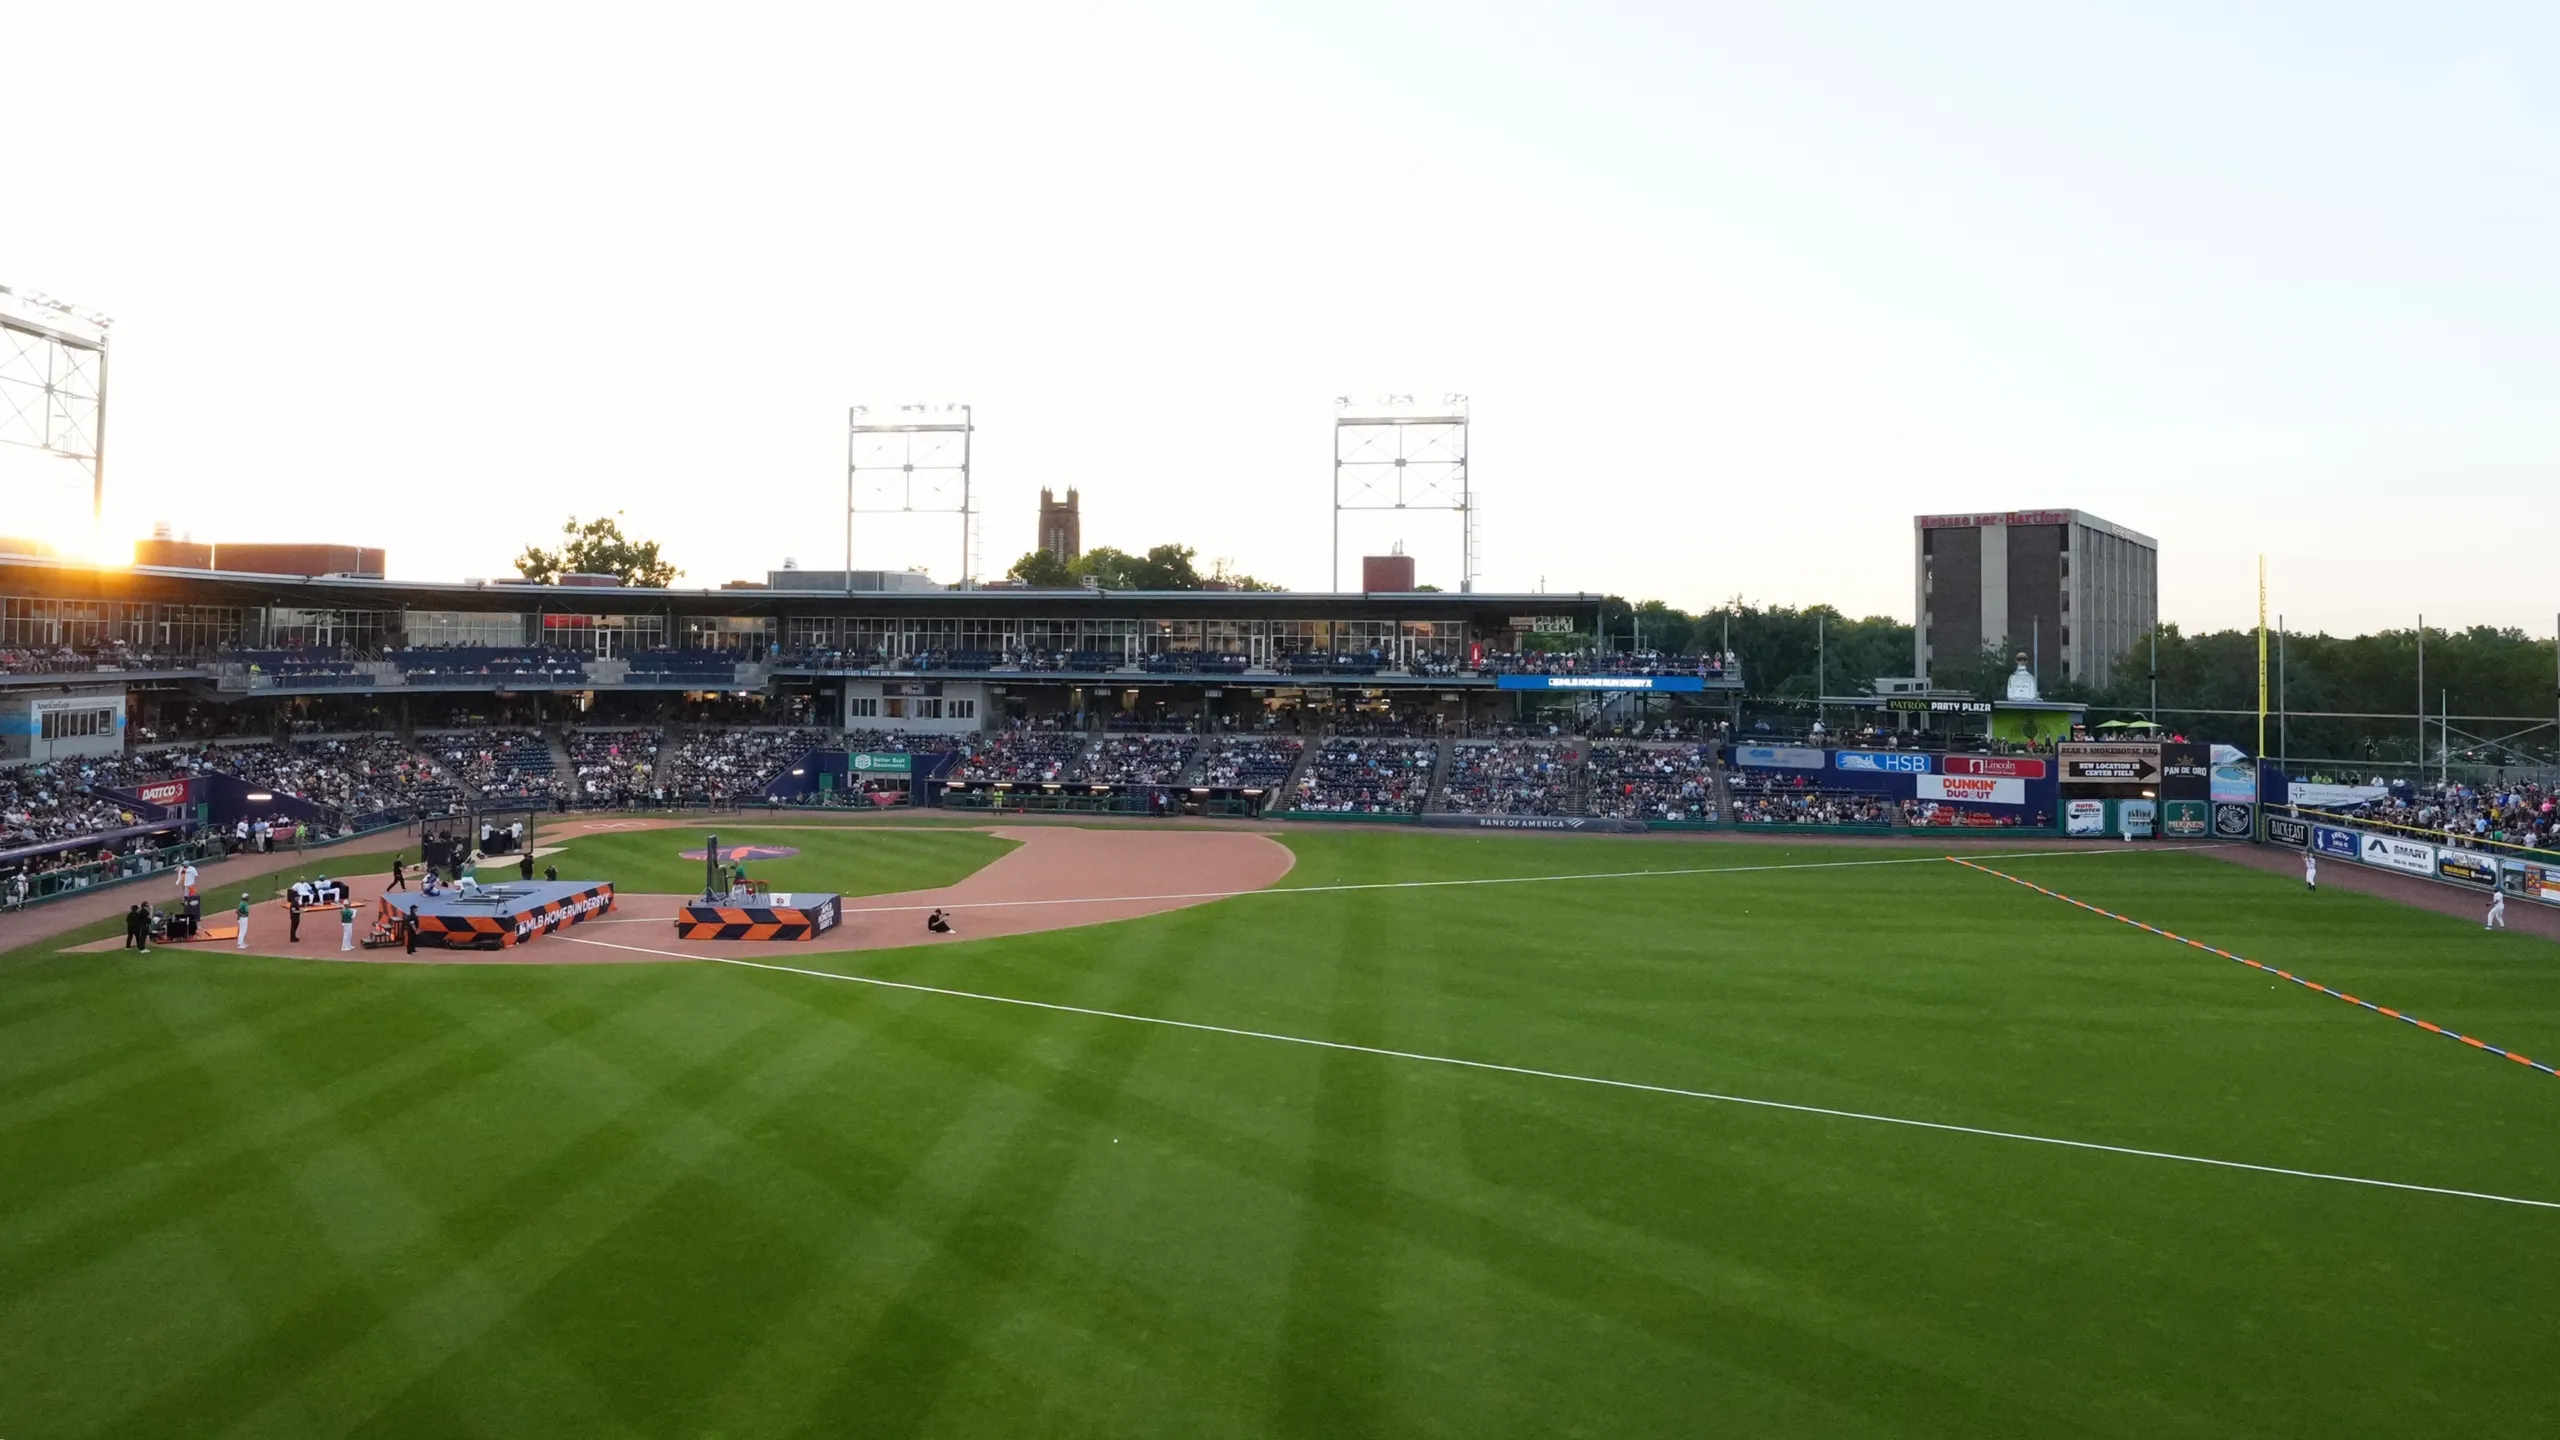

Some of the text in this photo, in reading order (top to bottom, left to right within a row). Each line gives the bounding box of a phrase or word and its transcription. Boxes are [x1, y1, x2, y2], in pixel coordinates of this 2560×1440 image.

[1535, 616, 1572, 624] PARTY
[1535, 624, 1571, 632] DECK!
[1890, 699, 1991, 712] PATRÓN PARTY PLAZA
[2061, 747, 2158, 756] BEAR'S SMOKEHOUSE BBQ
[1886, 755, 1925, 772] HSB
[1985, 759, 2016, 769] Lincoln
[2164, 766, 2207, 777] PAN DE ORO
[1943, 778, 1997, 791] DUNKIN'
[142, 785, 176, 801] DATTCO
[1946, 789, 1991, 799] DUGOUT
[1480, 819, 1565, 828] BANK OF AMERICA
[2272, 820, 2305, 840] BACK EAST
[2394, 845, 2428, 860] SMART
[526, 915, 544, 932] MLB
[544, 907, 567, 925] HOME
[567, 903, 582, 919] RUN
[583, 895, 604, 912] DERBY
